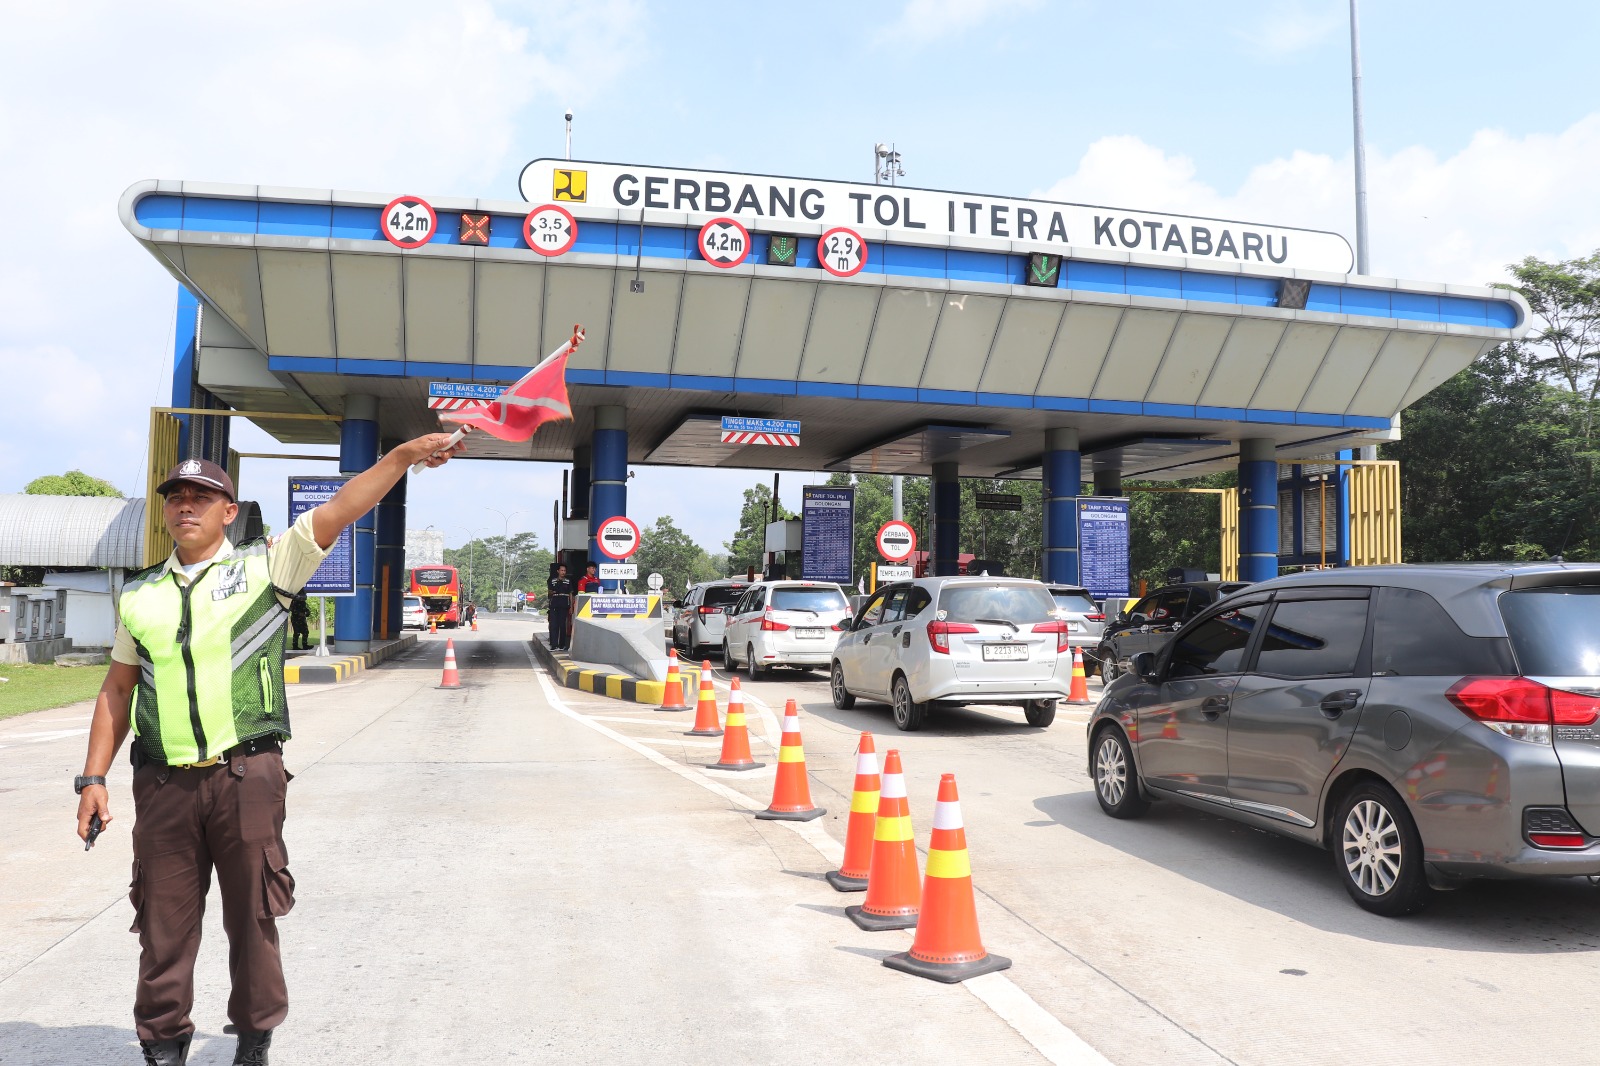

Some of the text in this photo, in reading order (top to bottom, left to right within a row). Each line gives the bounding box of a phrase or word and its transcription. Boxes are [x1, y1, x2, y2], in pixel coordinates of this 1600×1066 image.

[612, 173, 1288, 264] GERBANG TOL ITERA KOTABARU
[542, 233, 558, 243] m
[837, 257, 849, 270] m
[766, 420, 784, 428] 4.200
[879, 569, 896, 577] TEMPEL
[985, 646, 990, 655] B
[994, 646, 1011, 655] 2213
